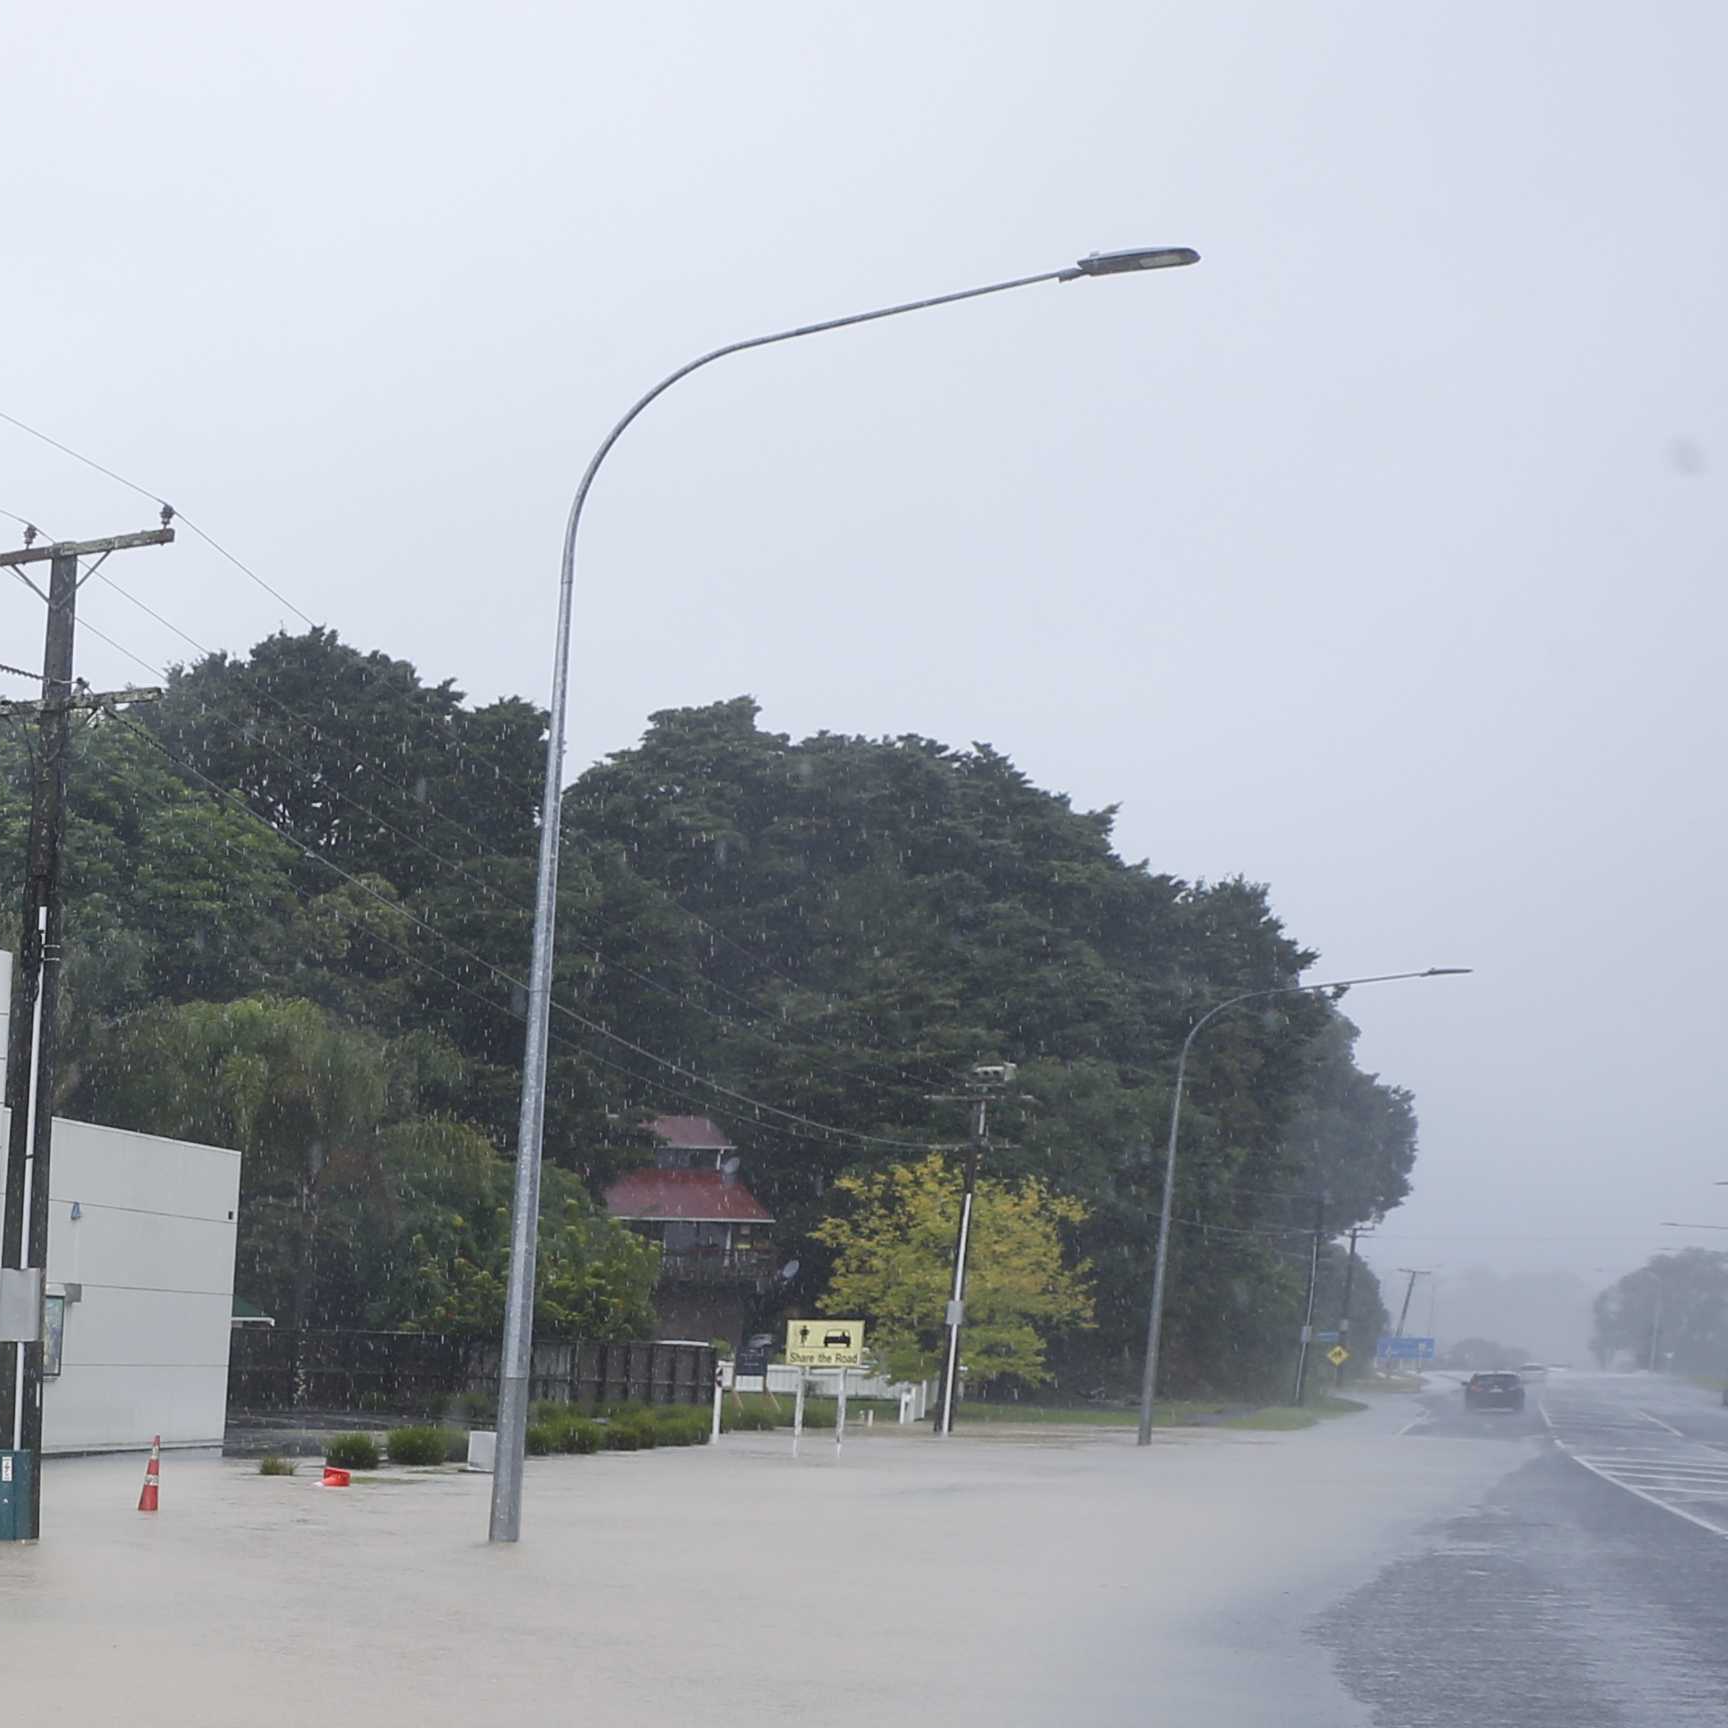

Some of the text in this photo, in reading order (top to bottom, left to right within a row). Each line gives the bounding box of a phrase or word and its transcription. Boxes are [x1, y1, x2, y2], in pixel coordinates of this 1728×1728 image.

[790, 1352, 858, 1364] Share the Road
